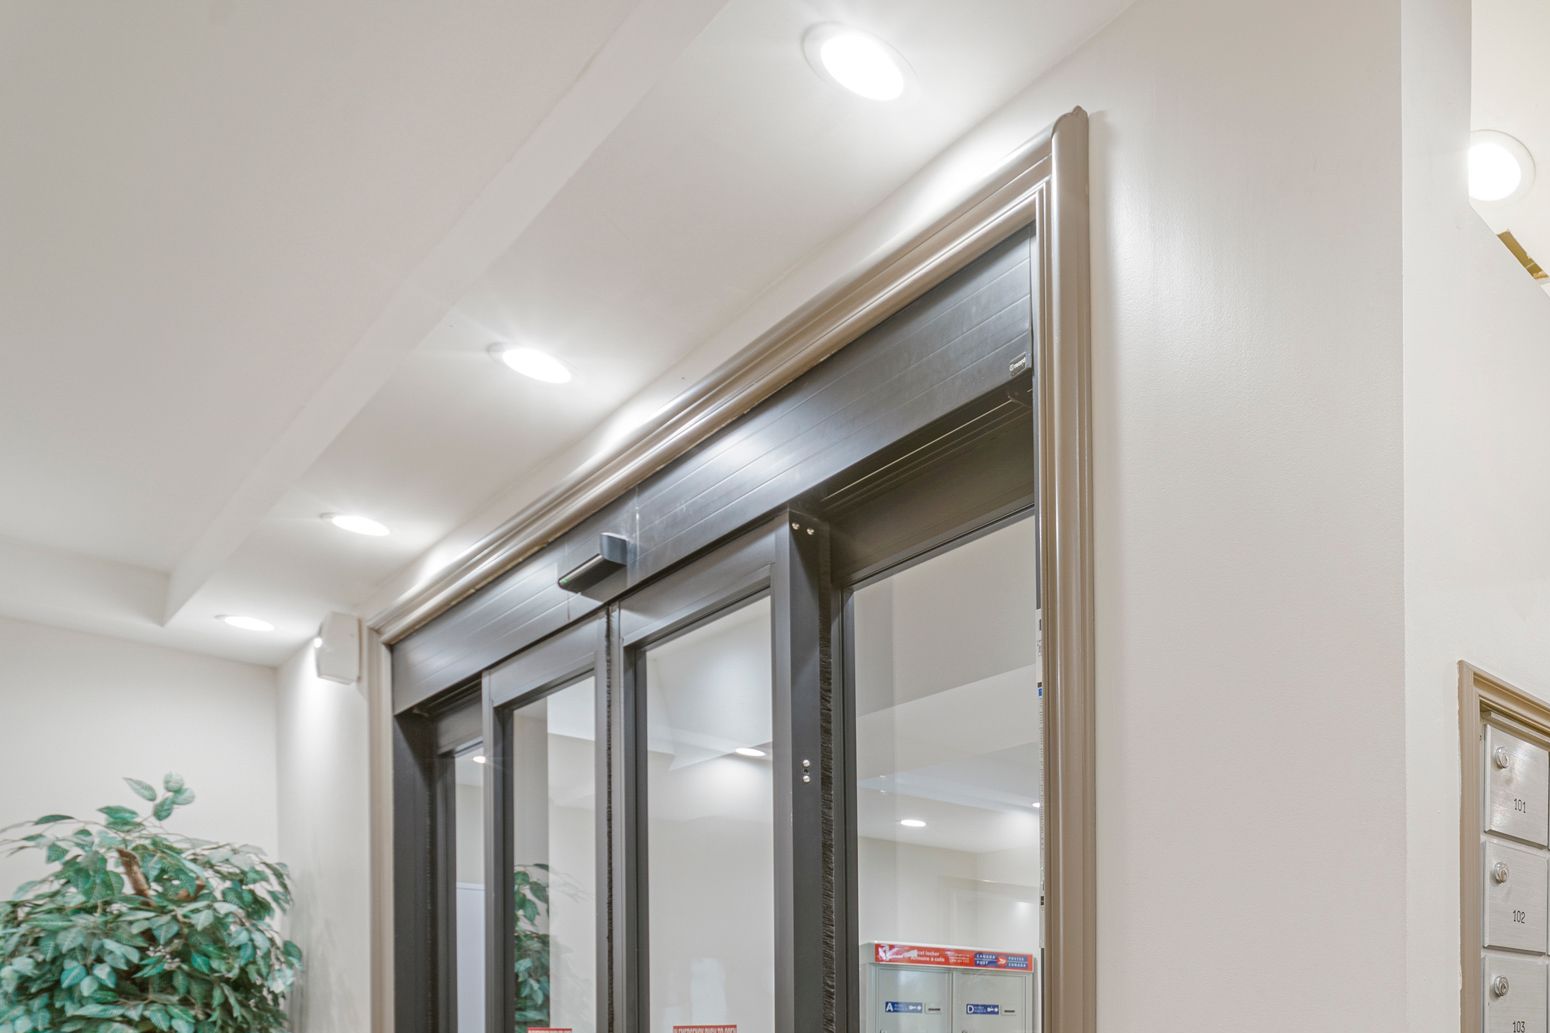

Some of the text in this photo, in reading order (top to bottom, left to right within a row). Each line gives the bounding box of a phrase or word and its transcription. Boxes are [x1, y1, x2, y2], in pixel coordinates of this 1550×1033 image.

[1513, 797, 1527, 814] 101
[1512, 910, 1526, 924] 102
[886, 1002, 894, 1012] A
[967, 1004, 974, 1014] D
[1512, 1020, 1526, 1033] 103
